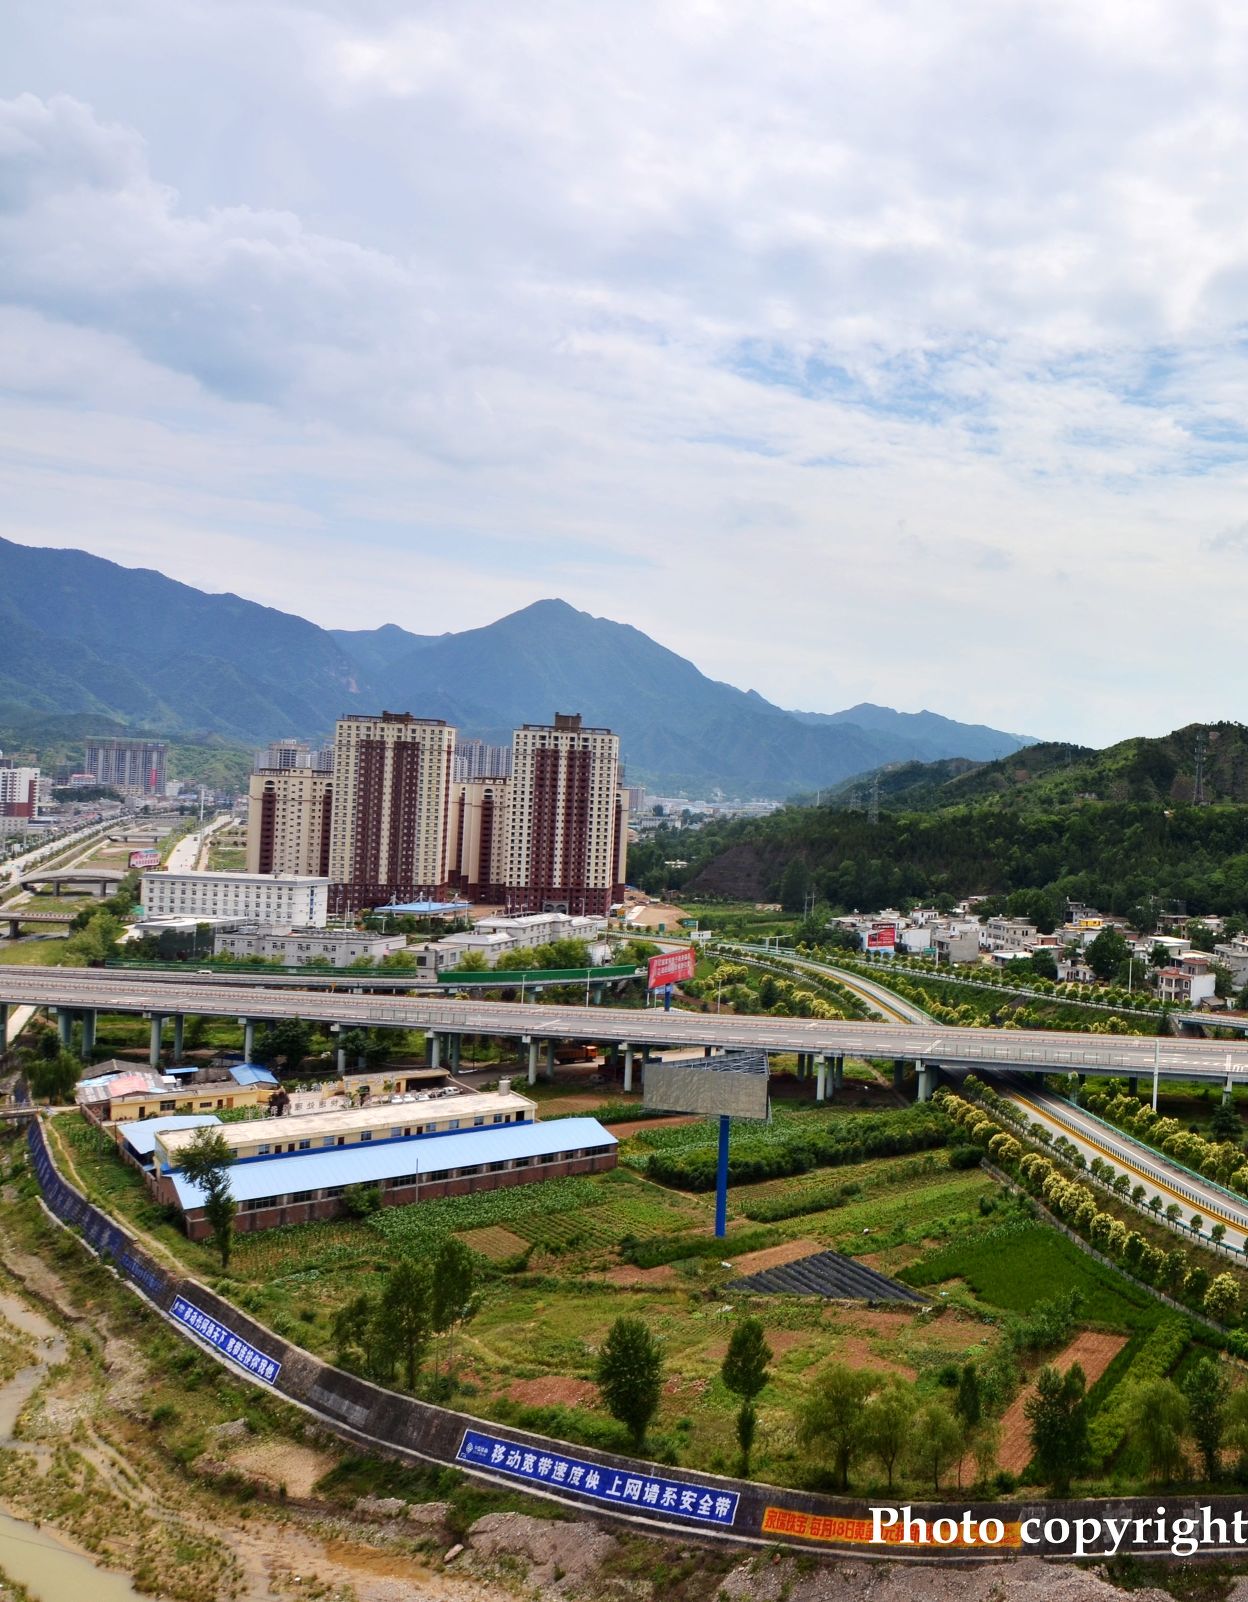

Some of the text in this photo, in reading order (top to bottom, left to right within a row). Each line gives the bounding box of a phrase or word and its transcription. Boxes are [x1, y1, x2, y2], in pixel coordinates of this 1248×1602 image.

[490, 1443, 732, 1518] 移动宽带速度快 上网请系安全带
